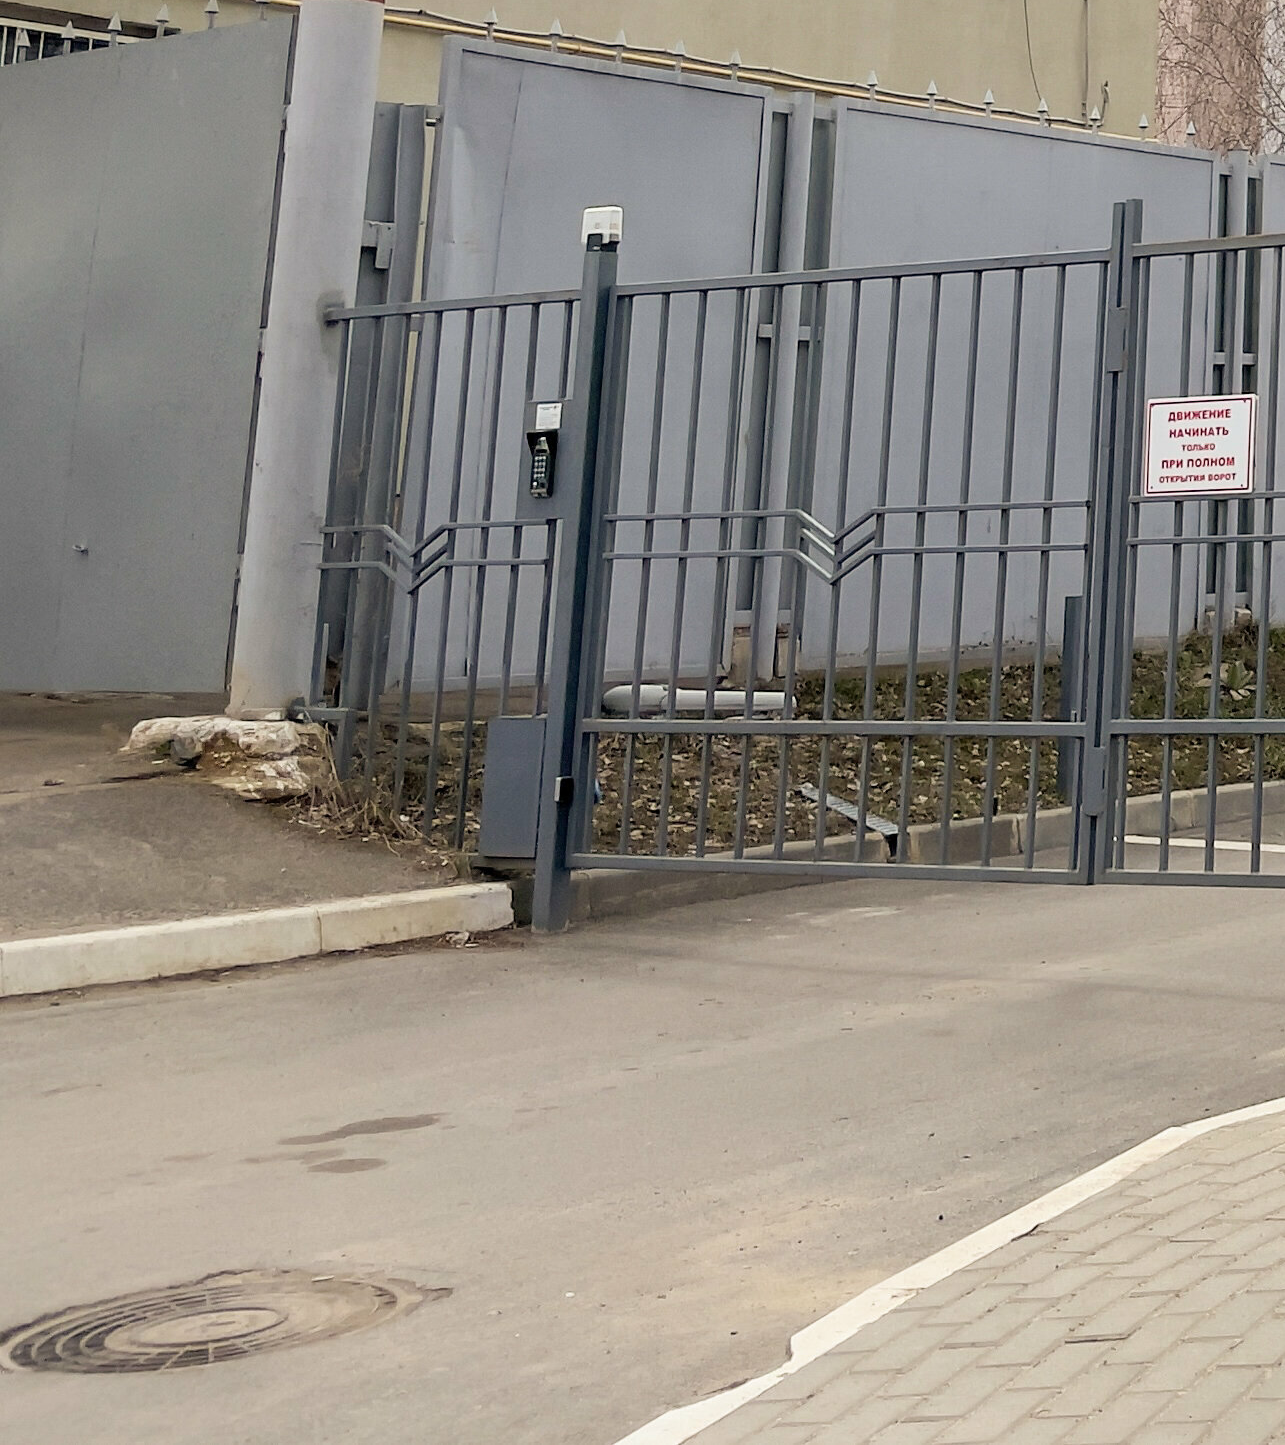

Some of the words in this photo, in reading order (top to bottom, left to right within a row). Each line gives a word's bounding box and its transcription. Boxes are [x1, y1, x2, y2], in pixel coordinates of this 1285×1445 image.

[1168, 408, 1232, 422] ДВИЖЕНИЕ
[1169, 426, 1229, 438] НАЧИНАТЬ
[1181, 443, 1216, 452] ТОЛЬКО
[1161, 459, 1183, 469] ПРИ
[1186, 457, 1235, 468] ПОЛНОМ
[1208, 473, 1237, 482] ВОРОТ
